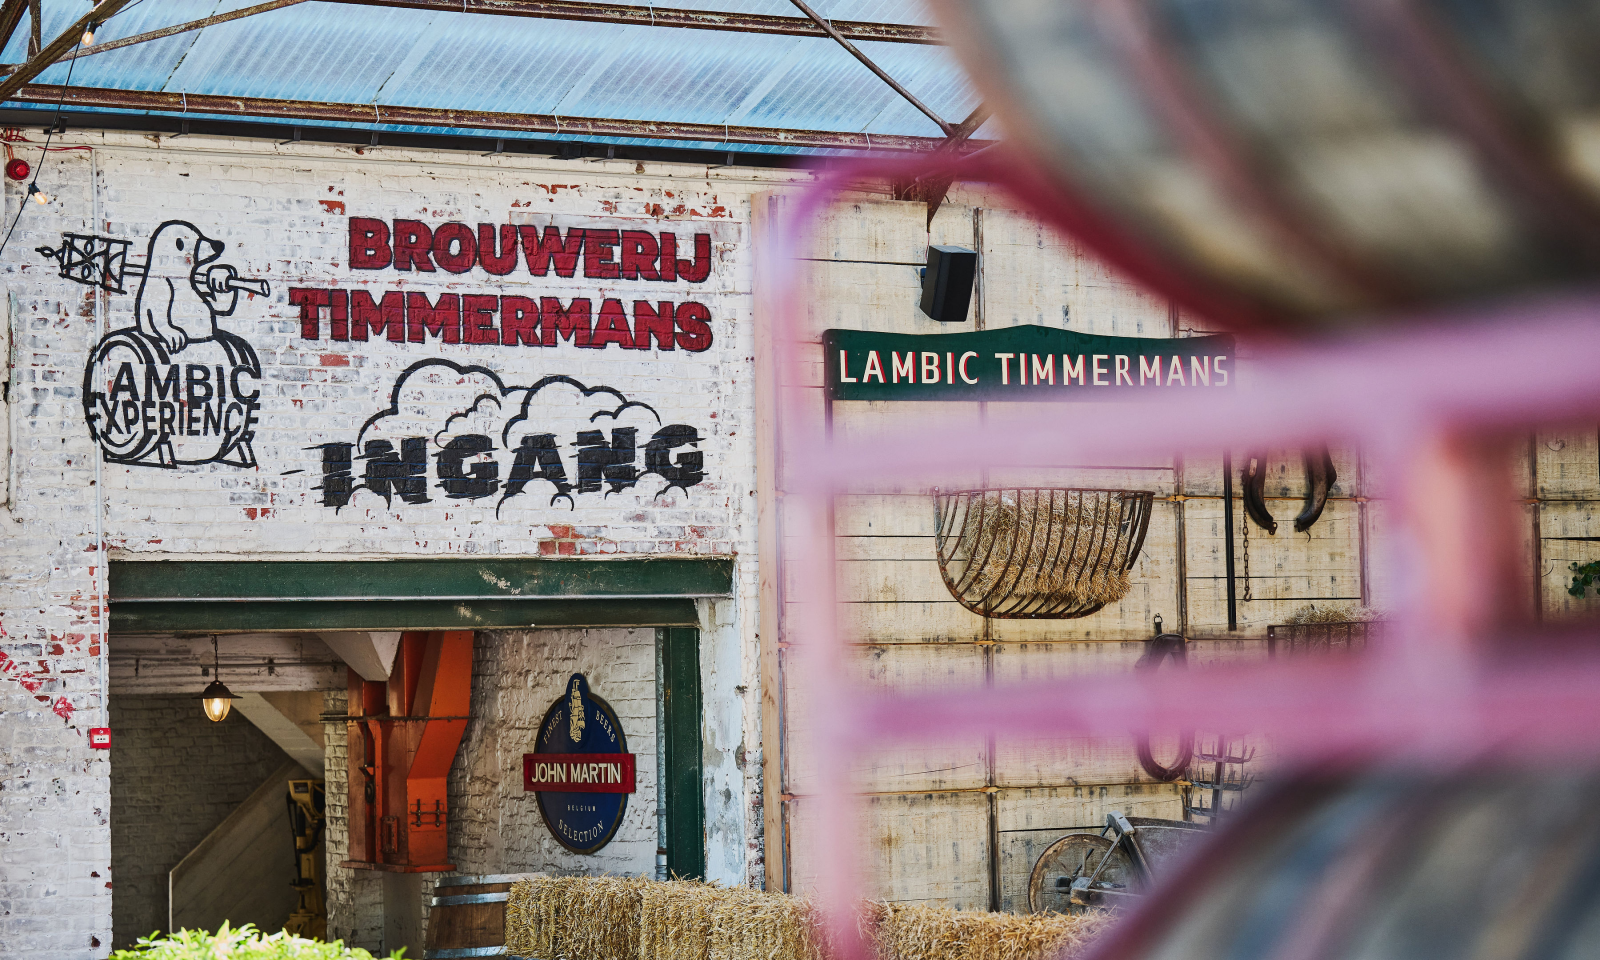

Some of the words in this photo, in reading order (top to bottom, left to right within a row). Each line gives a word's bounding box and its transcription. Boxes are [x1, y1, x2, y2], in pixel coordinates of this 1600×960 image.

[348, 216, 712, 283] BROUWERIJ
[288, 286, 714, 352] TIMMERMANS
[838, 349, 979, 385] LAMBIC
[994, 352, 1229, 387] TIMMERMANS
[83, 400, 261, 437] EXPERIENCE
[312, 423, 706, 507] INGANG
[543, 709, 564, 745] FINEST
[594, 709, 617, 743] BEERS
[531, 762, 568, 783] JOHN
[570, 762, 623, 784] MARTIN
[567, 804, 596, 812] BELGIUM
[558, 818, 605, 843] SELECTION
